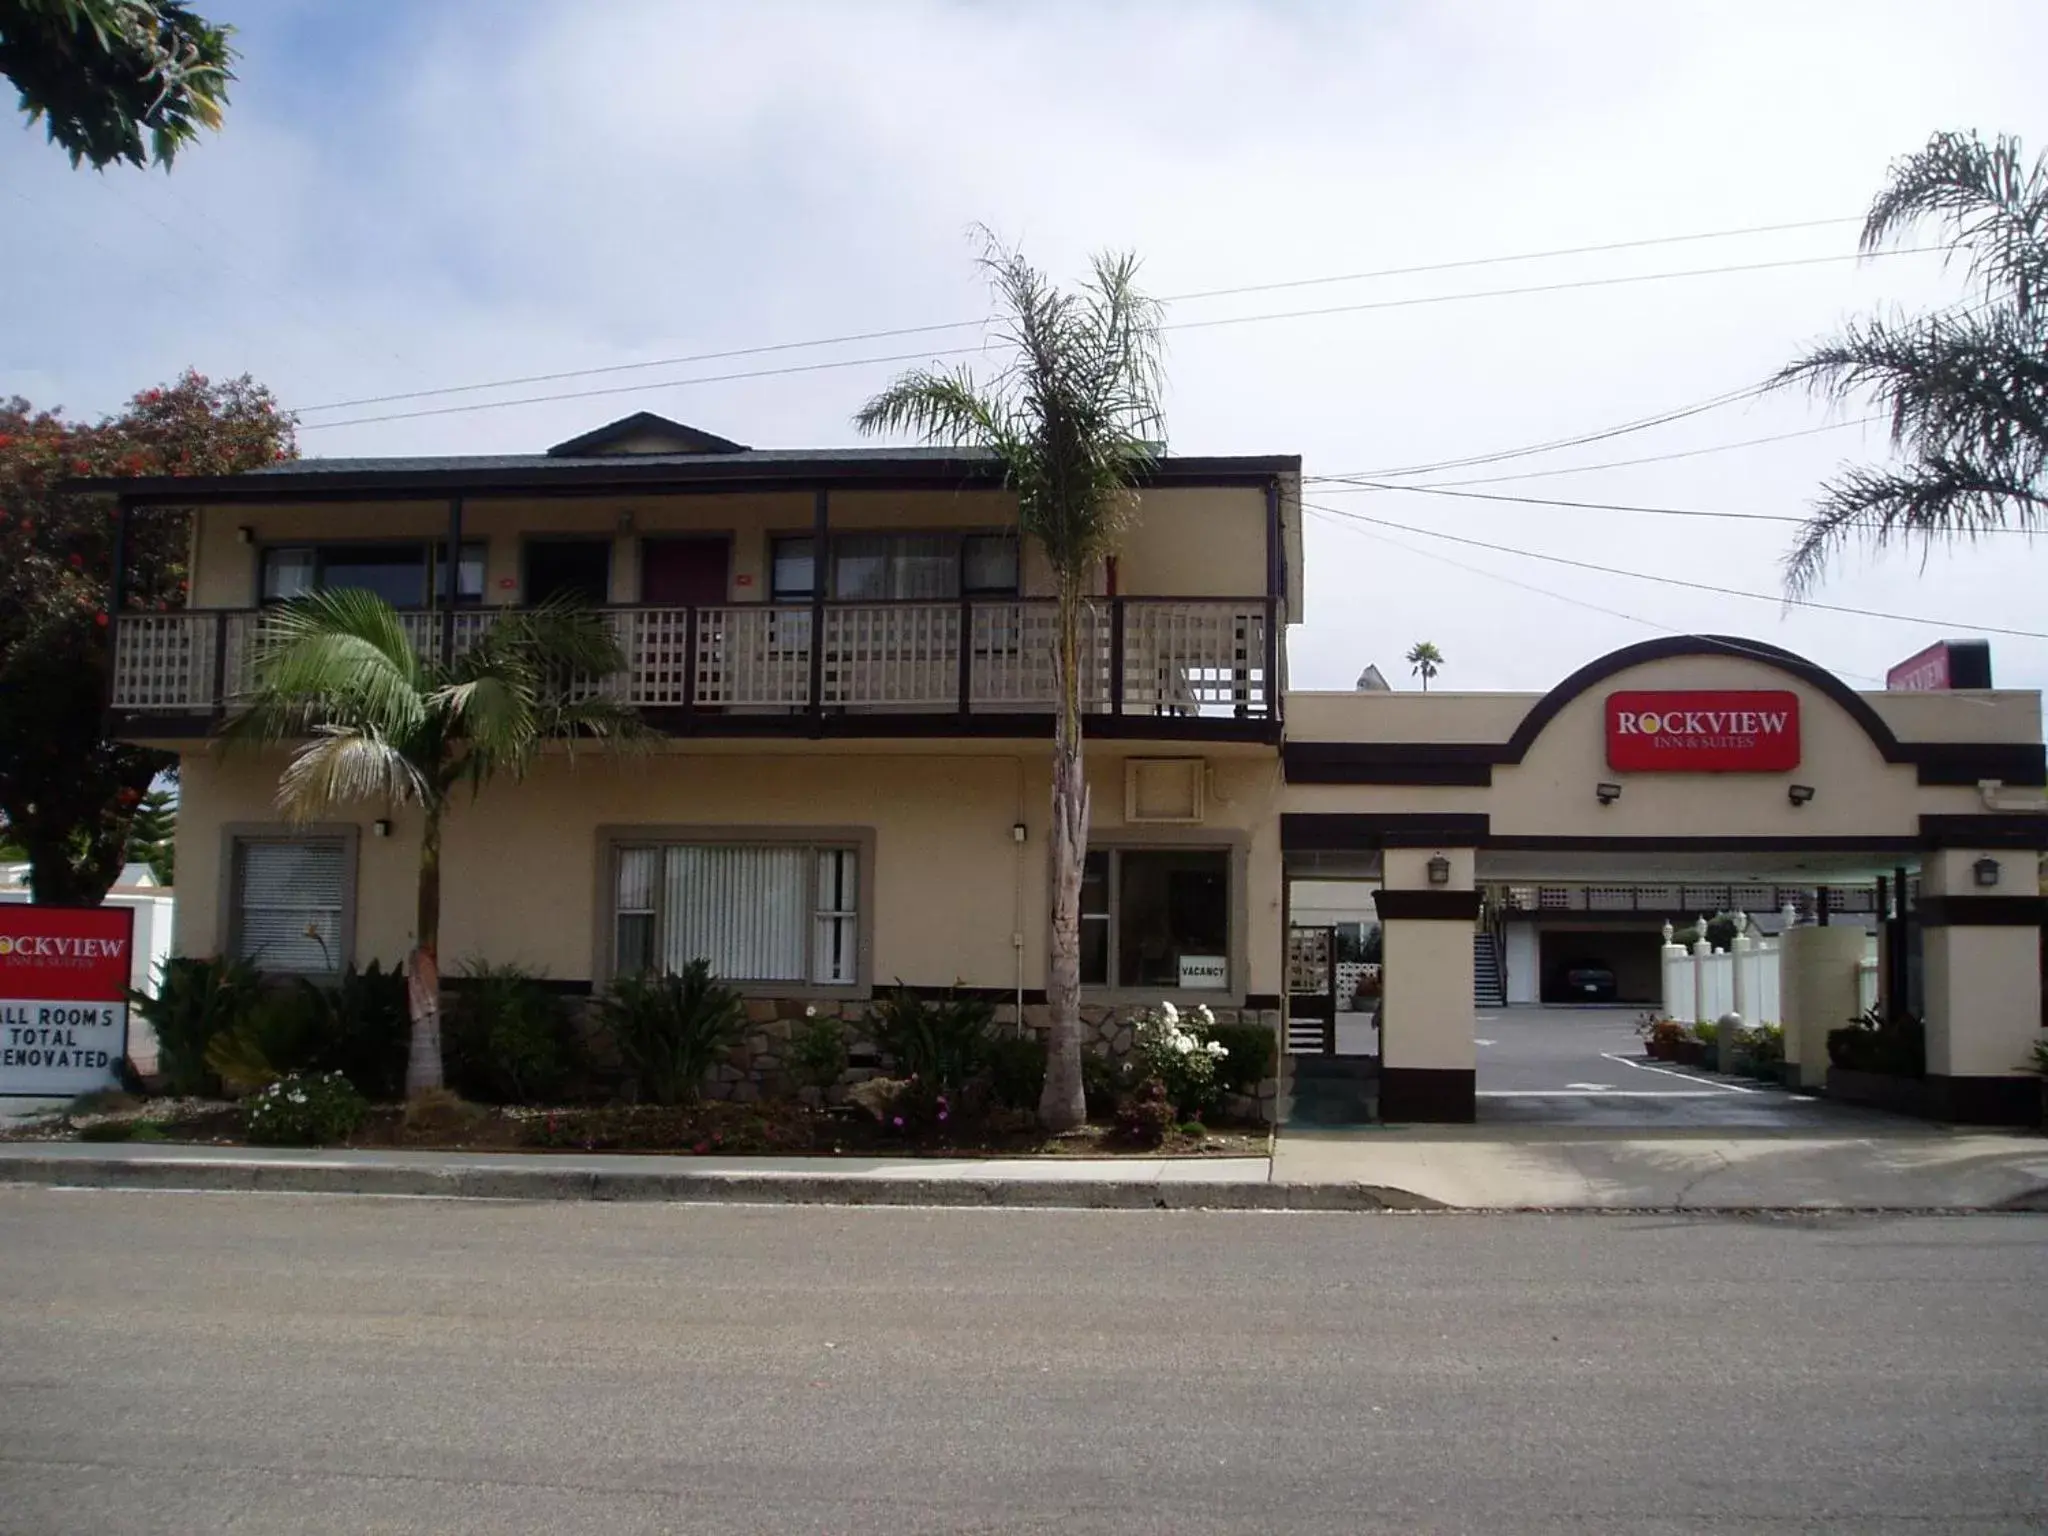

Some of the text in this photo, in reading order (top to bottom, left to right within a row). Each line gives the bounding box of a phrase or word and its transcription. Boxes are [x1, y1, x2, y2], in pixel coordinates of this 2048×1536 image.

[1618, 711, 1788, 735] ROCKVIEW
[1655, 736, 1684, 748] INN
[1701, 736, 1754, 748] SUITES
[0, 935, 126, 958] OCKVIEW
[1183, 967, 1224, 977] VACANCY
[39, 1007, 113, 1027] ROOMS
[10, 1028, 77, 1046] TOTAL
[0, 1048, 108, 1068] ENOVATED
